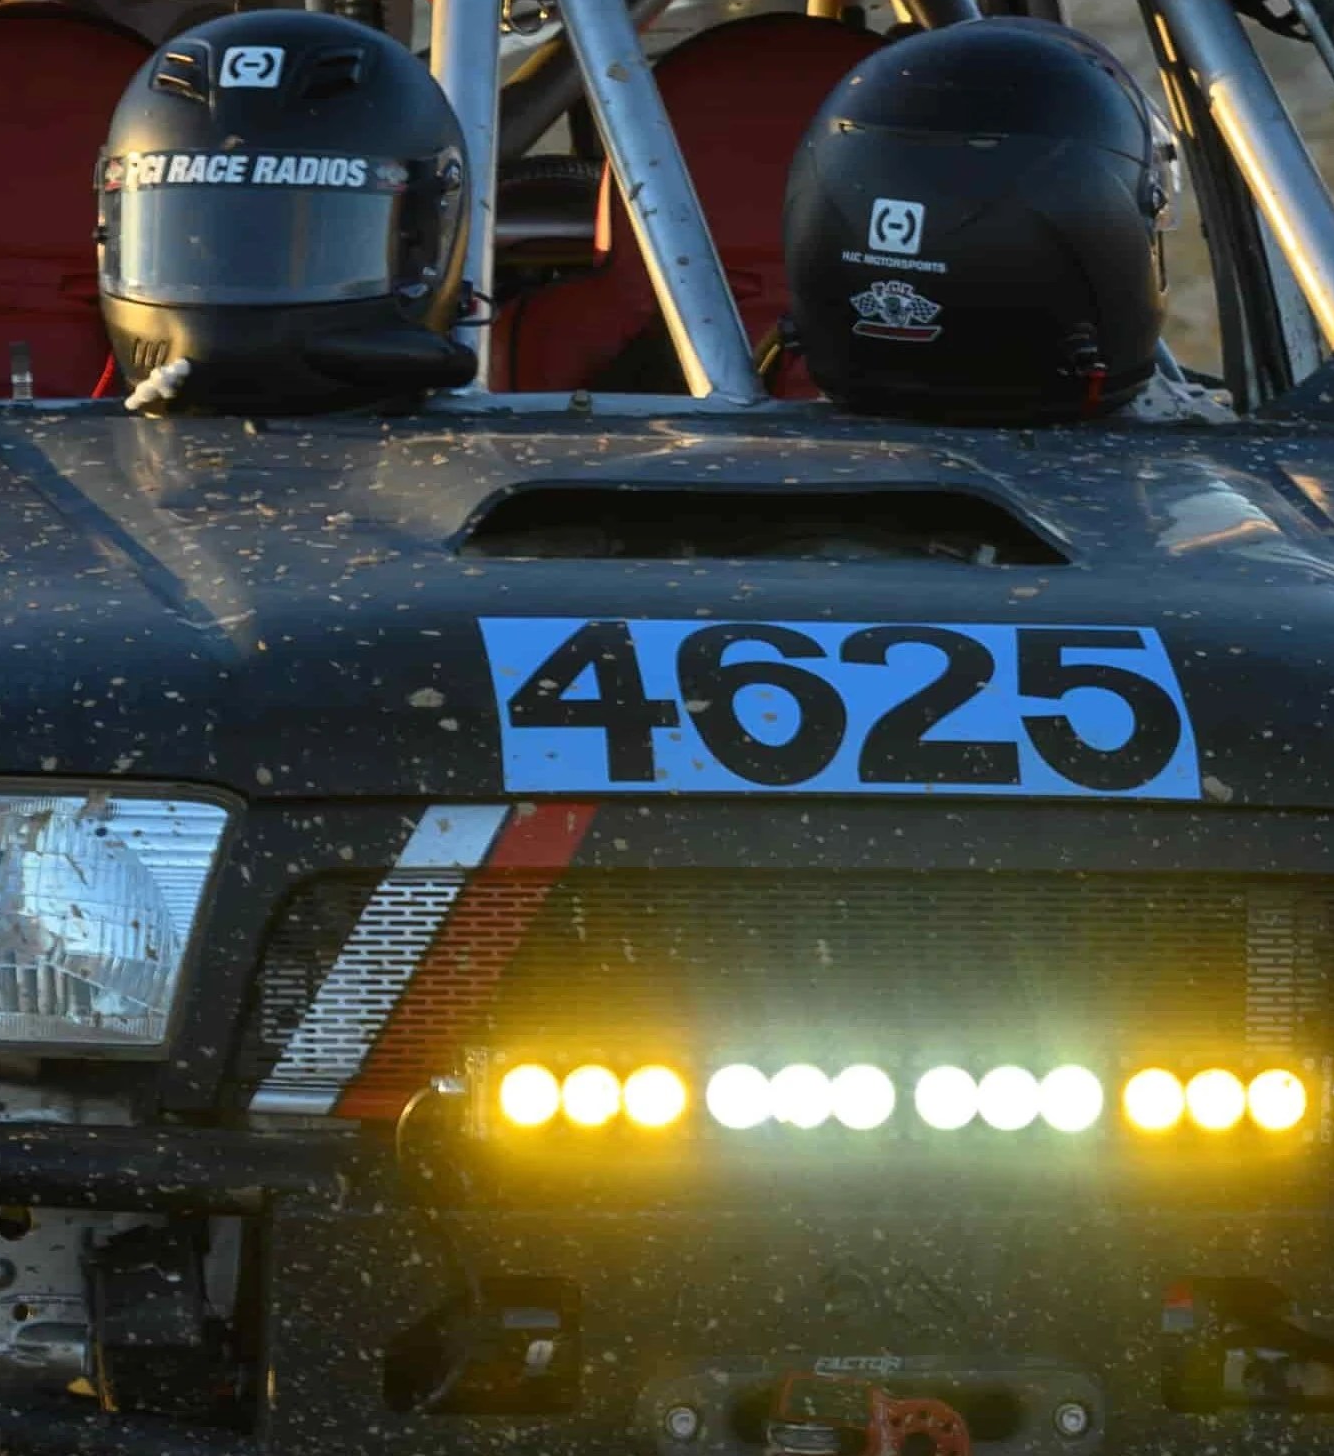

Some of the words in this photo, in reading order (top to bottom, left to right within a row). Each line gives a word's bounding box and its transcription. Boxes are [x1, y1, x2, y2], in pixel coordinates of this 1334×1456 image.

[168, 153, 248, 184] RACE
[251, 155, 367, 187] RADIOS
[508, 619, 1183, 791] 4625
